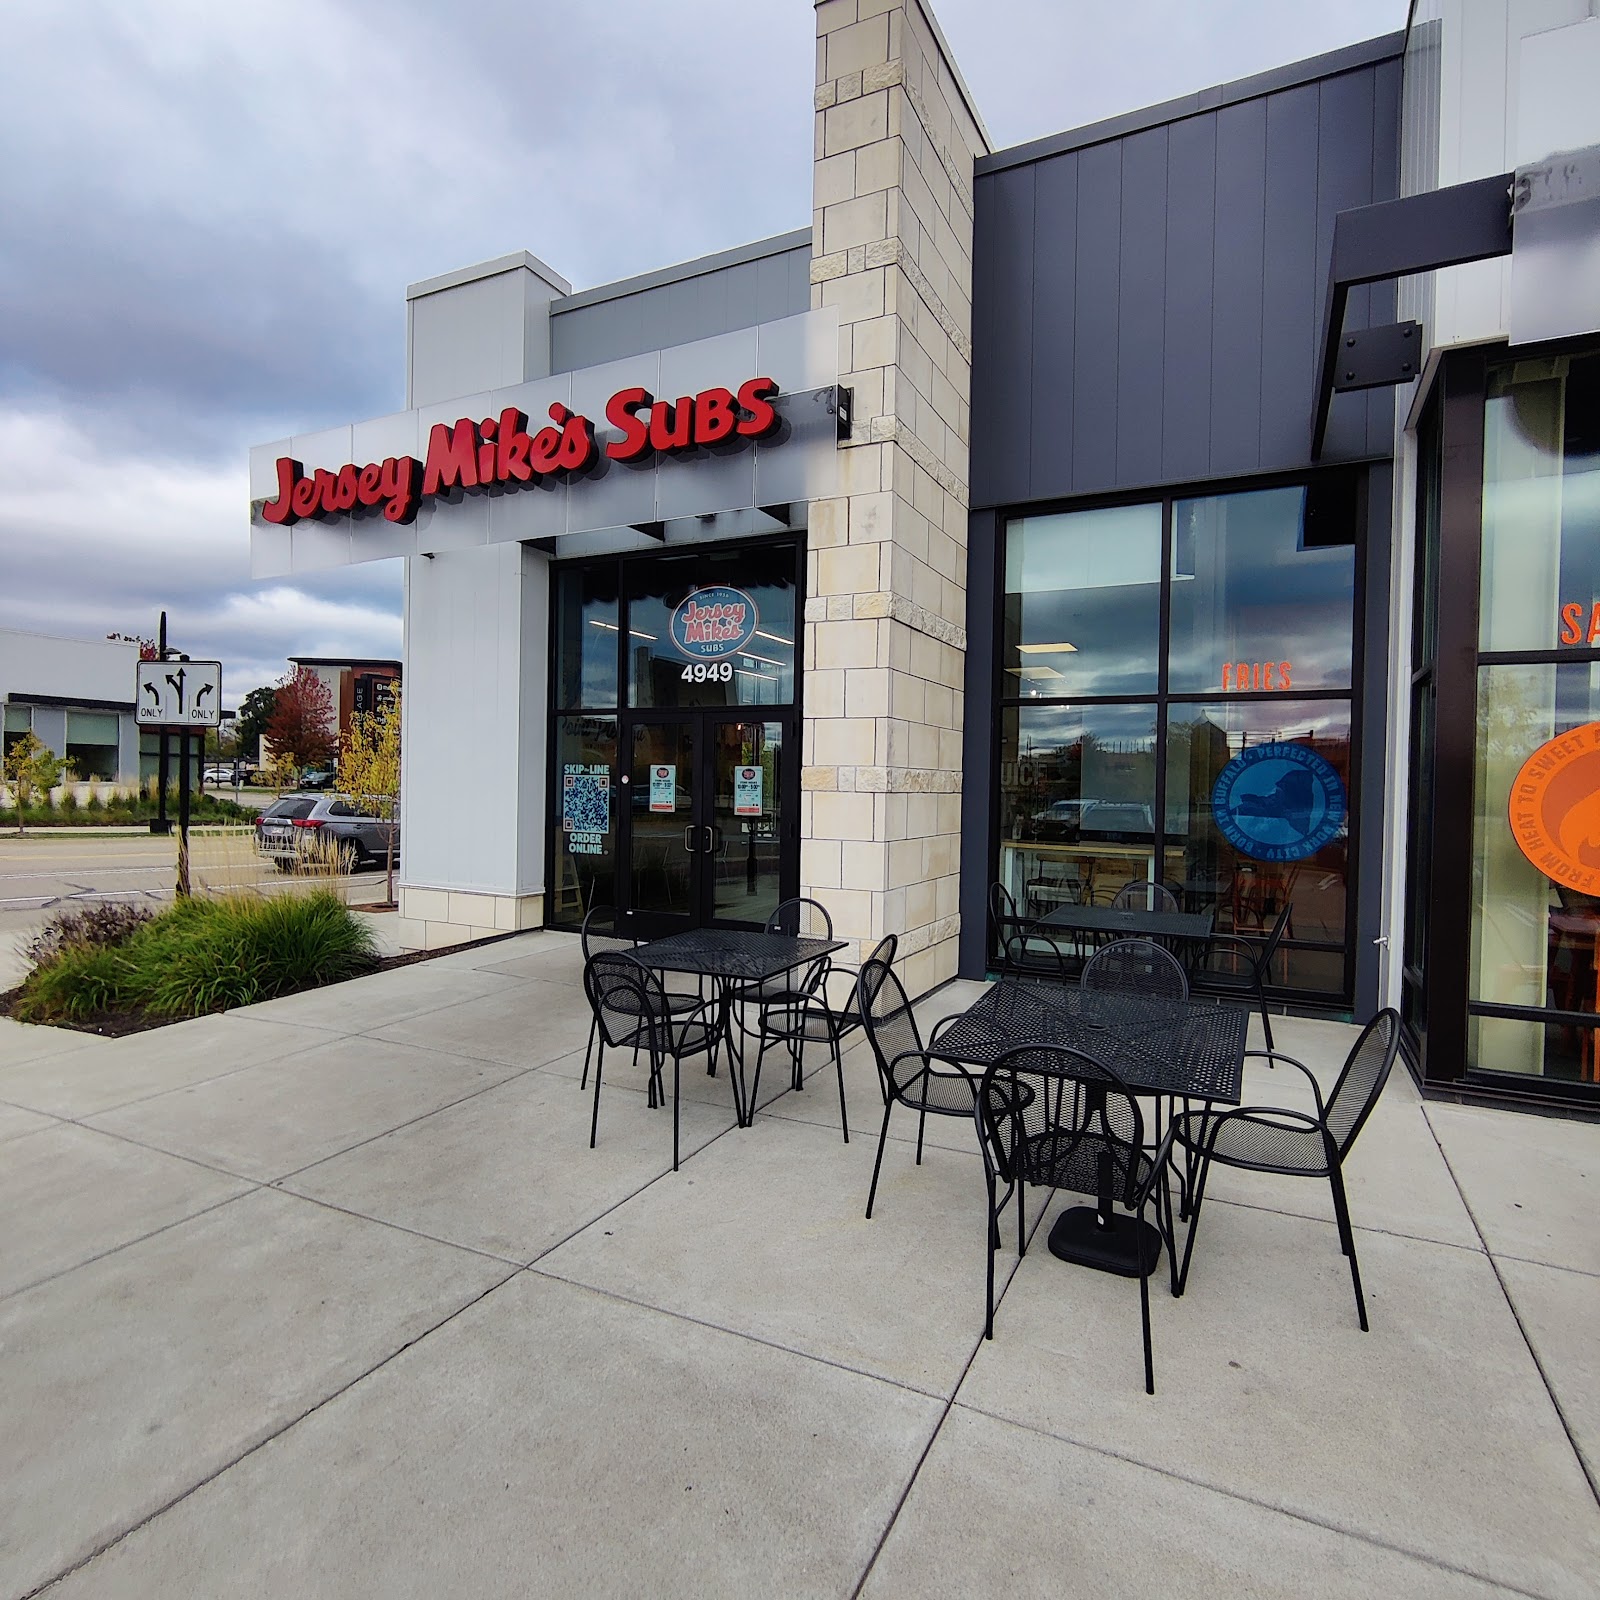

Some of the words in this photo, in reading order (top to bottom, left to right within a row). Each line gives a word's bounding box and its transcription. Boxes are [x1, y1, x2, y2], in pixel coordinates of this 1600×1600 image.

[262, 456, 417, 524] Jersey
[422, 401, 596, 495] Mike's
[699, 592, 715, 600] SINCE
[682, 602, 745, 623] Jersey
[685, 619, 744, 643] Mike's
[700, 643, 725, 653] SUBS
[681, 662, 733, 682] 4949
[1222, 661, 1291, 691] FRIES
[141, 707, 163, 718] ONLY
[191, 709, 215, 719] ONLY
[1256, 746, 1328, 775] PERFECTED
[1528, 734, 1585, 780] SWEET
[1214, 759, 1247, 805] BUFFALO
[1517, 784, 1537, 803] TO
[1327, 794, 1342, 822] NEW
[569, 833, 602, 843] ORDER
[1223, 825, 1254, 852] BORN
[1302, 825, 1334, 852] YORK
[1517, 812, 1545, 851] HEAT
[568, 843, 603, 855] ONLINE
[1266, 846, 1300, 859] CITY
[1539, 851, 1595, 889] FROM
